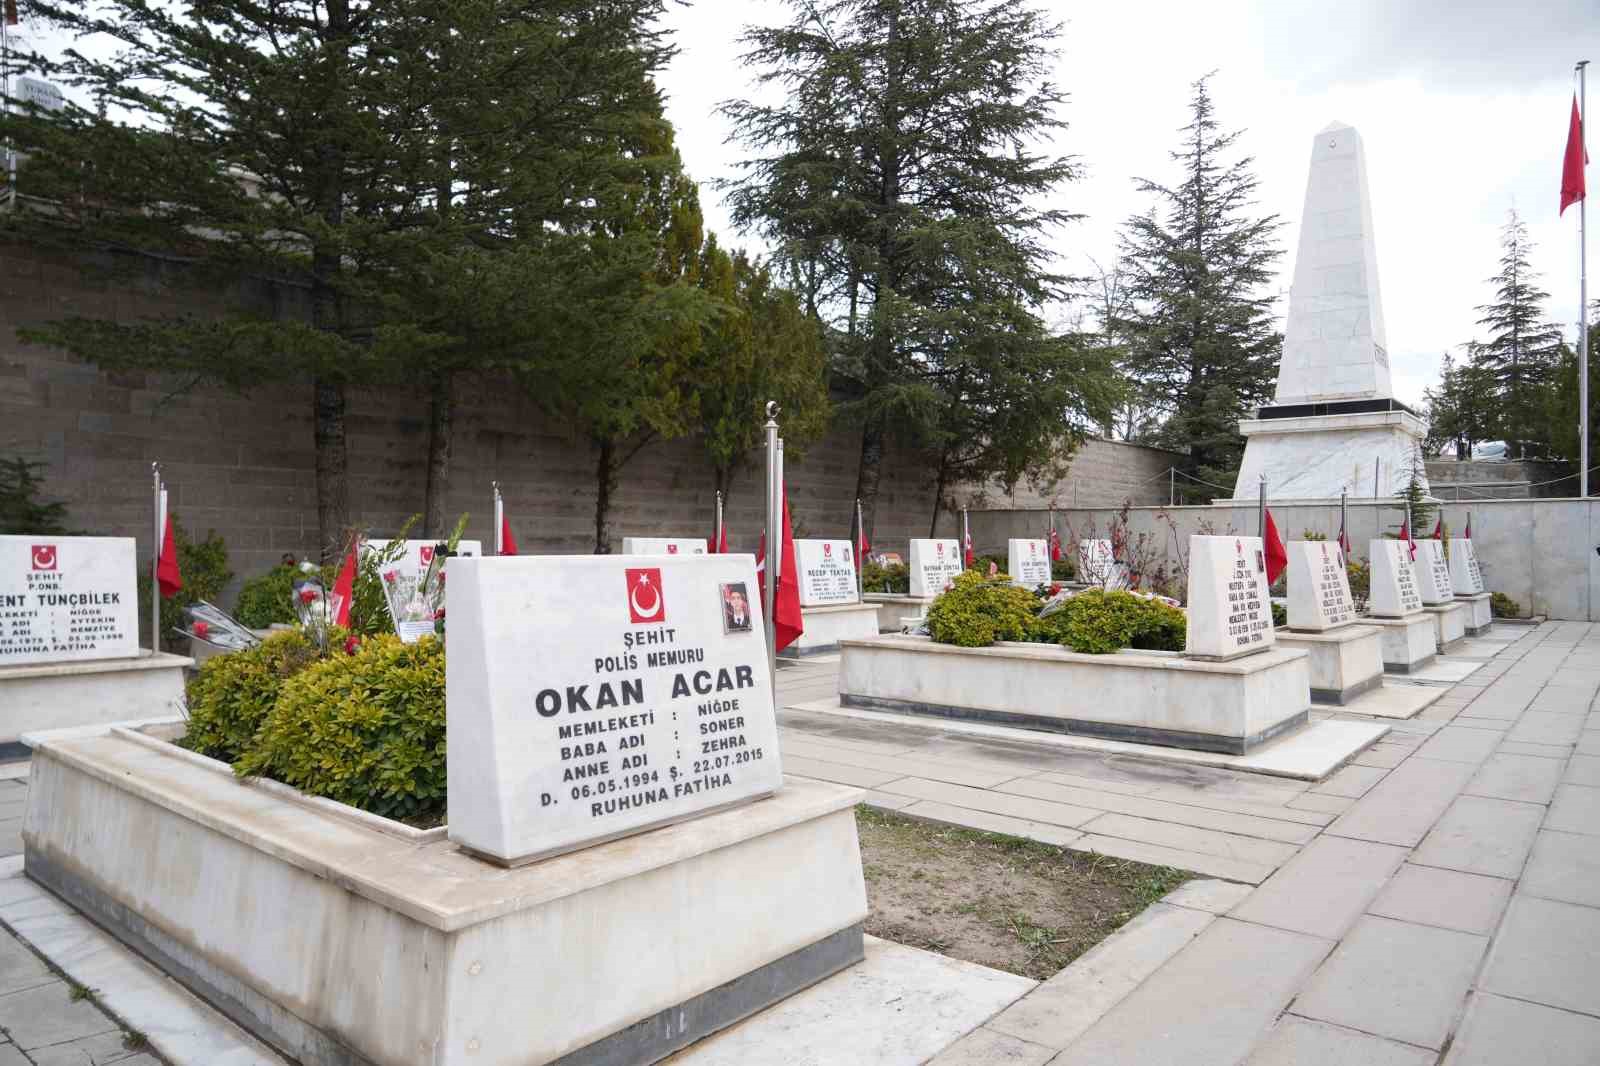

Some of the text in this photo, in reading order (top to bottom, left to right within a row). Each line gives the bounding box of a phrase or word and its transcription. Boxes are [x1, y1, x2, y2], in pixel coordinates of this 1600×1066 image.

[38, 592, 121, 608] TUNÇBİLEK
[595, 648, 704, 673] POLİS MEMURU
[624, 626, 676, 650] ŞEHİT
[535, 665, 754, 718] OKAN ACAR
[559, 711, 654, 740] MEMLEKETİ
[698, 699, 740, 717] NİĞDE
[561, 741, 607, 761] BABA
[619, 734, 645, 750] ADI
[700, 716, 745, 735] SONER
[541, 792, 558, 807] D.
[571, 771, 659, 800] 06.05.1994
[693, 748, 763, 773] 22.07.2015
[562, 761, 609, 782] ANNE
[621, 753, 648, 771] ADI
[701, 734, 746, 754] ZEHRA
[591, 772, 732, 817] RUHUNA FATİHA
